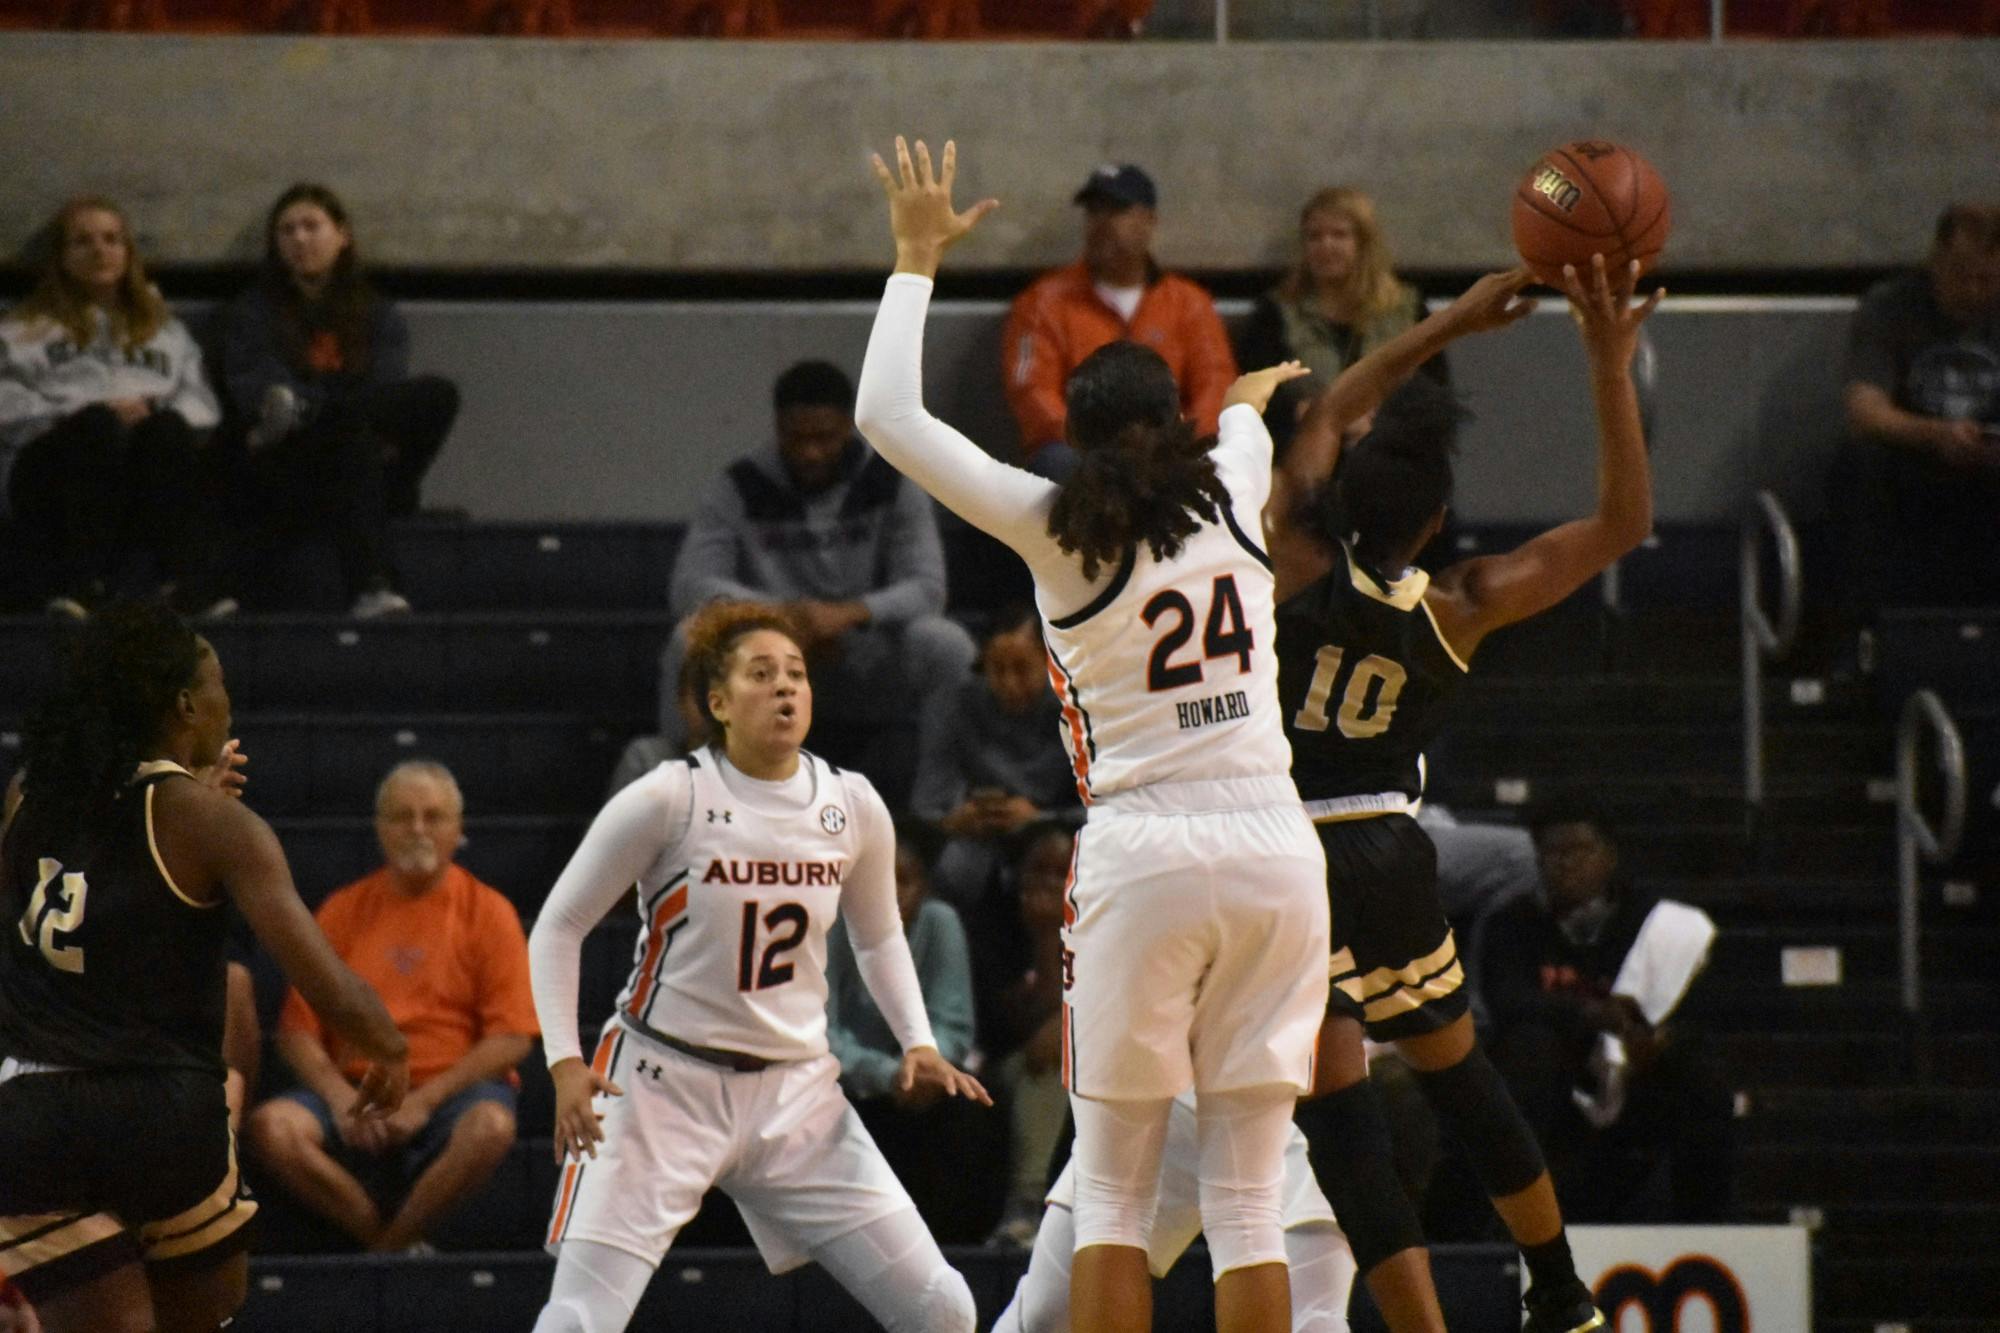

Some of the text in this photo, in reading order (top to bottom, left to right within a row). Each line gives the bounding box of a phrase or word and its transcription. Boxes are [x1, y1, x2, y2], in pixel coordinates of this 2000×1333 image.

[1139, 573, 1255, 693] 24
[1176, 691, 1250, 729] HOWARD
[1294, 645, 1407, 738] 10
[18, 857, 88, 974] 12
[702, 860, 842, 886] AUBURN
[738, 901, 809, 993] 12
